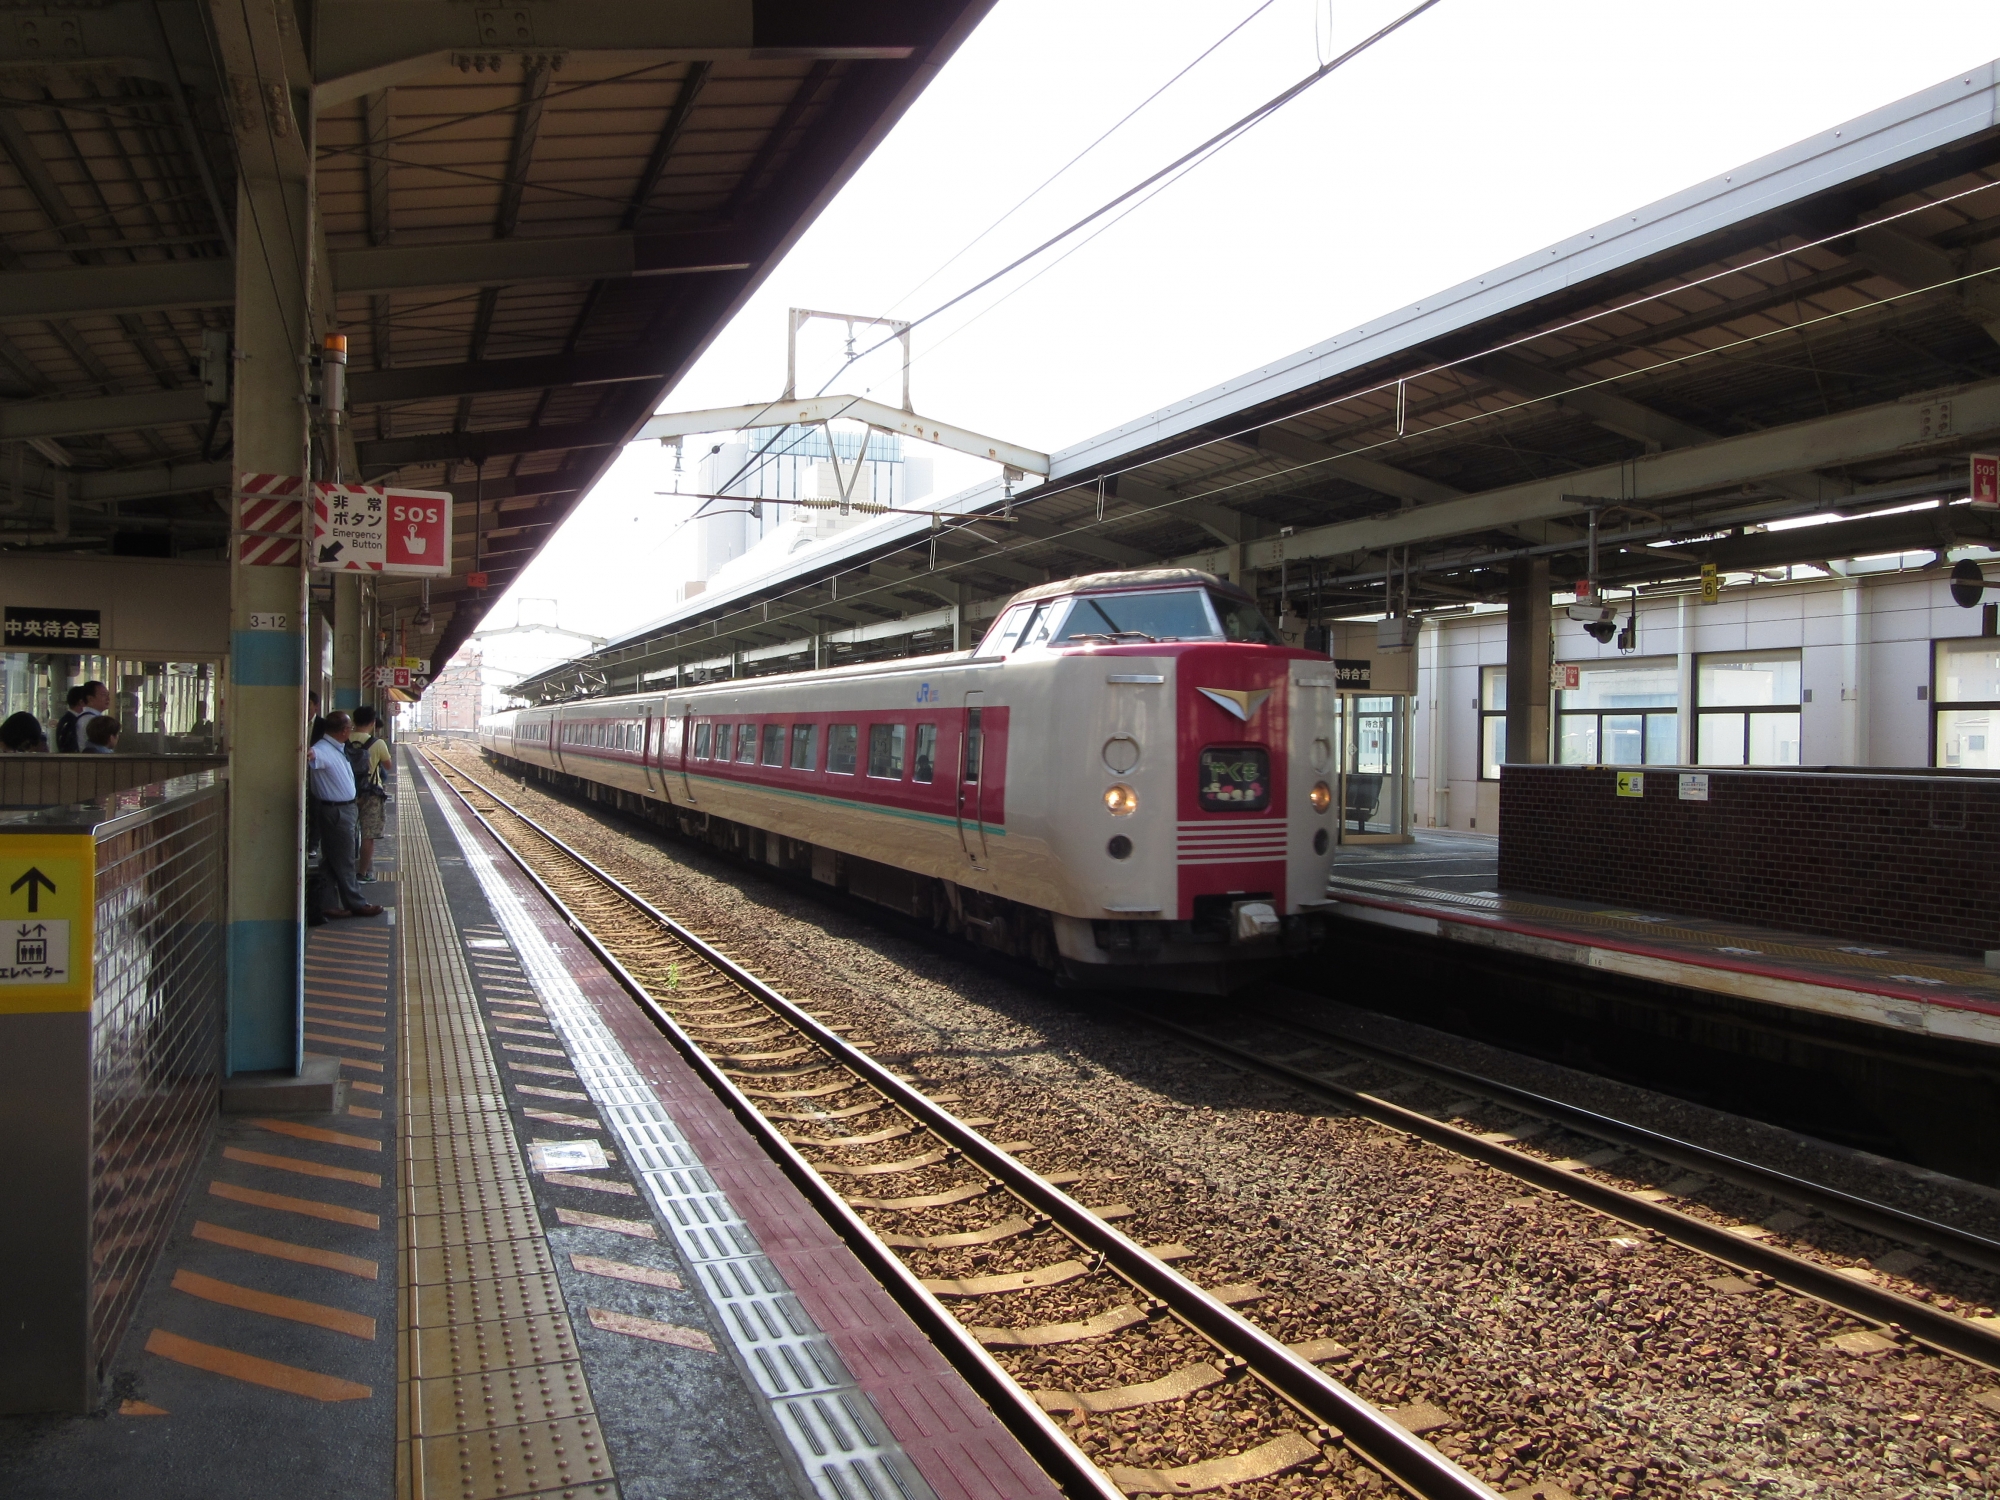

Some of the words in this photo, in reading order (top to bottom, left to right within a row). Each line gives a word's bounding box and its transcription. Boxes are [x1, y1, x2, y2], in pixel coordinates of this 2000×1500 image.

[1976, 464, 1995, 476] SOS
[333, 495, 382, 512] 非常
[333, 511, 382, 527] ボタン
[393, 505, 438, 523] SOS
[332, 528, 382, 540] Emergency
[352, 539, 382, 550] Button
[1704, 582, 1713, 596] 6
[4, 618, 100, 639] 中央待合室
[250, 615, 286, 628] 3-12
[1208, 761, 1260, 782] やくも
[0, 966, 65, 979] エレベーター
